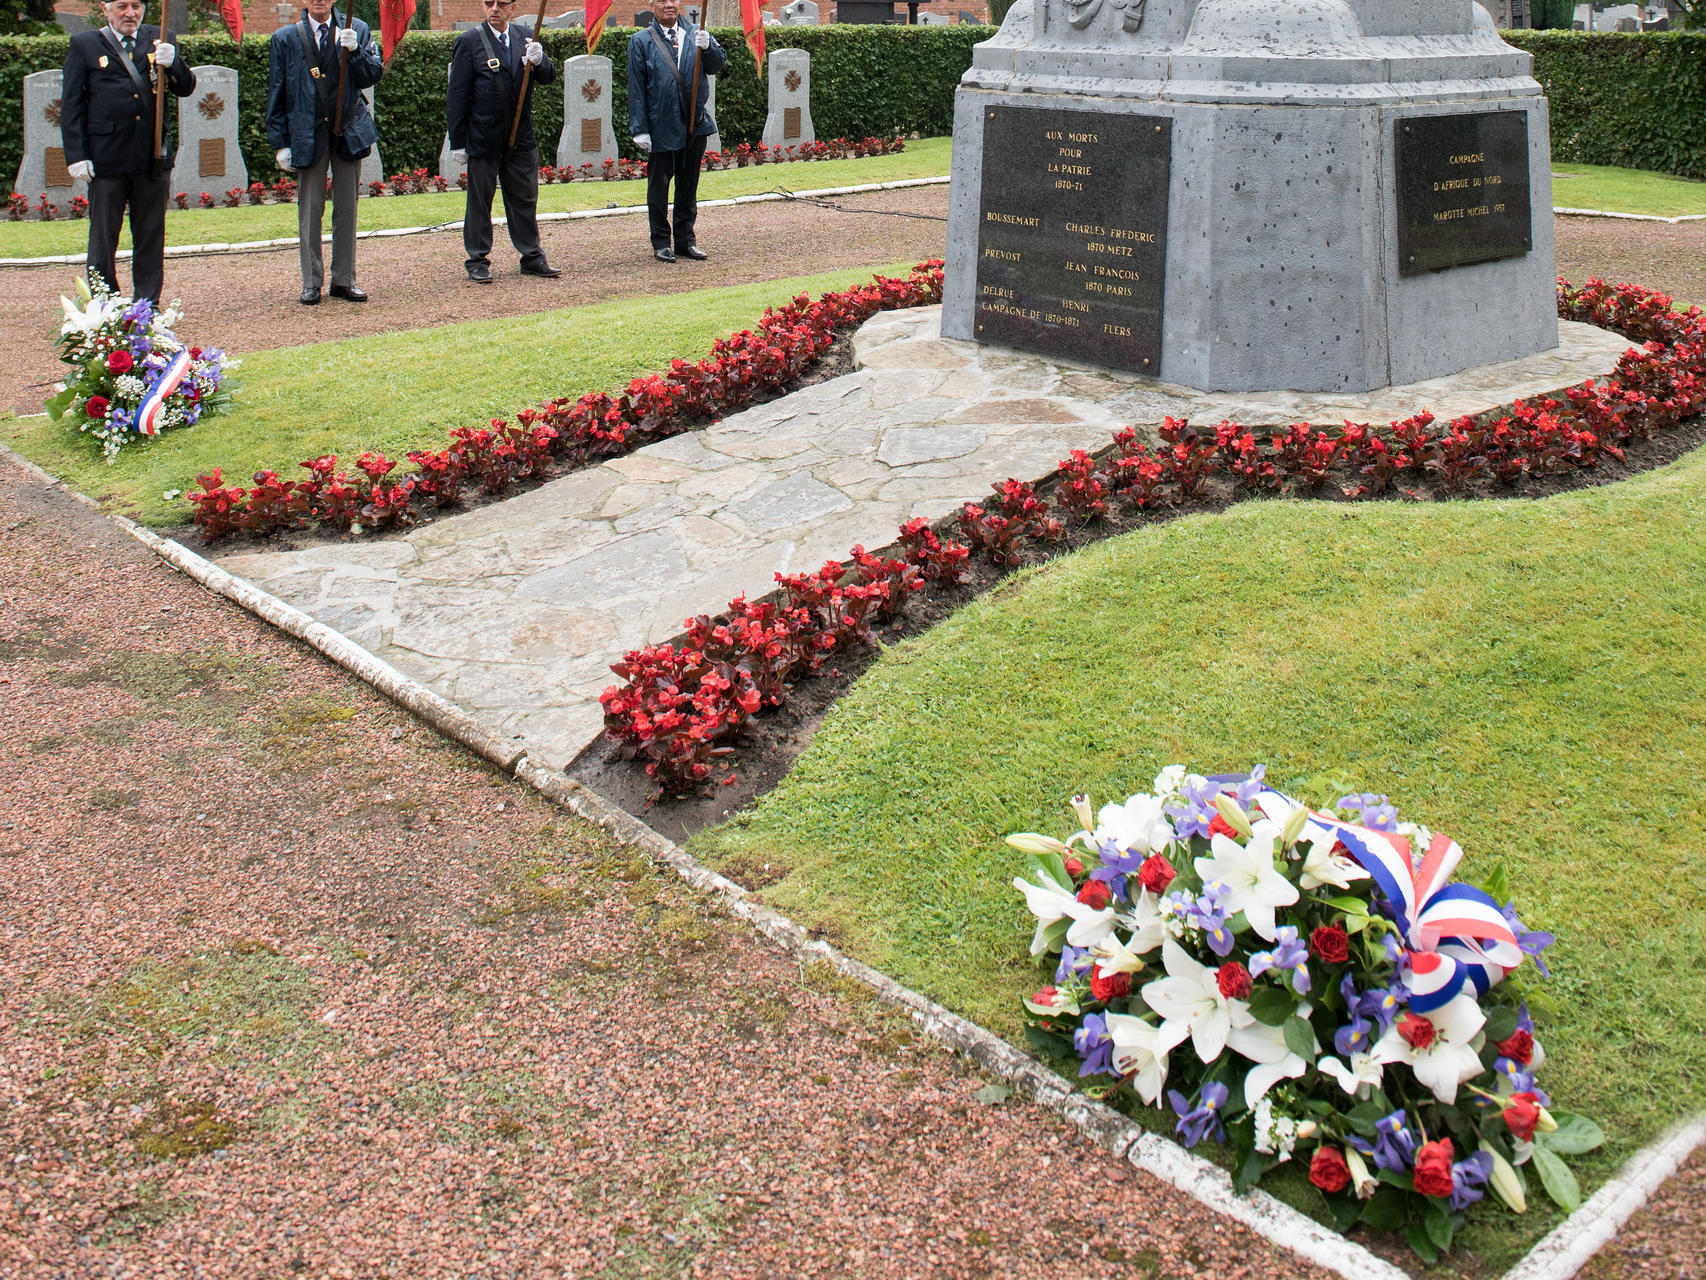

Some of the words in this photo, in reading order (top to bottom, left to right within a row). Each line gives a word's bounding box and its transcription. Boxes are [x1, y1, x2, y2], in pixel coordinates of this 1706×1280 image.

[1045, 131, 1063, 140] AUX
[1068, 131, 1098, 142] MORTS
[1059, 147, 1082, 158] POUR
[1449, 152, 1484, 164] CAMPAGNE
[1047, 163, 1059, 172] LA
[1061, 164, 1092, 175] PATRIE
[1054, 179, 1082, 190] 1870-71
[1473, 177, 1481, 186] DU
[1484, 175, 1501, 185] NORD
[1433, 208, 1464, 221] MAROTTE
[1467, 206, 1490, 216] MICHEL
[986, 211, 1040, 227] BOUSSEMART
[1065, 222, 1105, 235] CHARLES
[1086, 242, 1104, 253] 1870
[1106, 244, 1133, 256] METZ
[984, 248, 1021, 261] PREVOST
[1064, 260, 1087, 272] JEAN
[1093, 264, 1140, 280] FRANÇOIS
[1084, 281, 1102, 291] 1870
[1105, 284, 1132, 296] PARIS
[983, 286, 1014, 298] DELRUE
[1062, 299, 1089, 312] HENRI
[981, 302, 1028, 318] CAMPAGNE
[1030, 309, 1040, 319] DE
[1044, 312, 1079, 326] 1870-1871
[1103, 323, 1131, 336] FLERS
